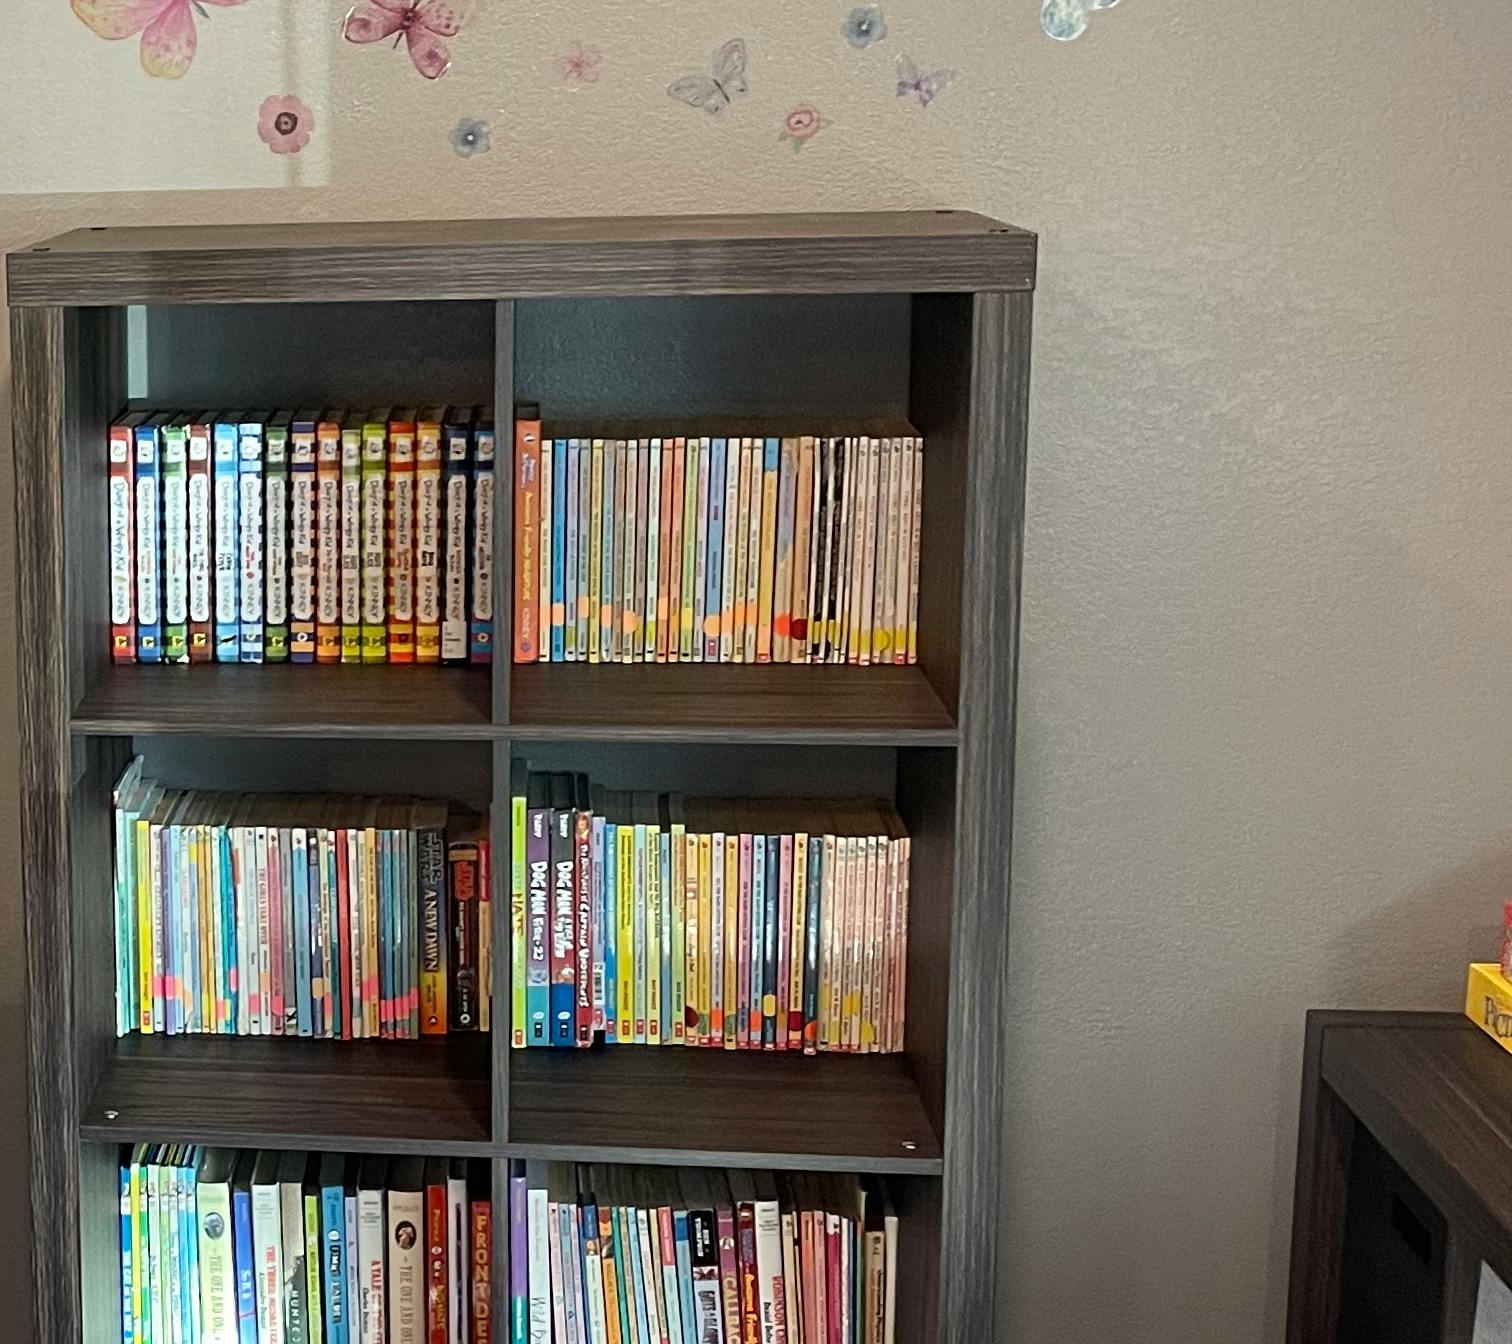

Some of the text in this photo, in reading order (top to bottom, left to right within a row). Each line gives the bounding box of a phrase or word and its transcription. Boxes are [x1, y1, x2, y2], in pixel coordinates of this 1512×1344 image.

[530, 861, 548, 915] DOG MAN
[556, 861, 574, 888] DOG
[424, 900, 438, 931] NEW
[556, 889, 573, 915] MAN
[425, 933, 439, 971] DAWN
[475, 1215, 489, 1298] FRONT
[400, 1266, 413, 1283] THE
[400, 1285, 413, 1302] ONE
[400, 1306, 413, 1324] AND
